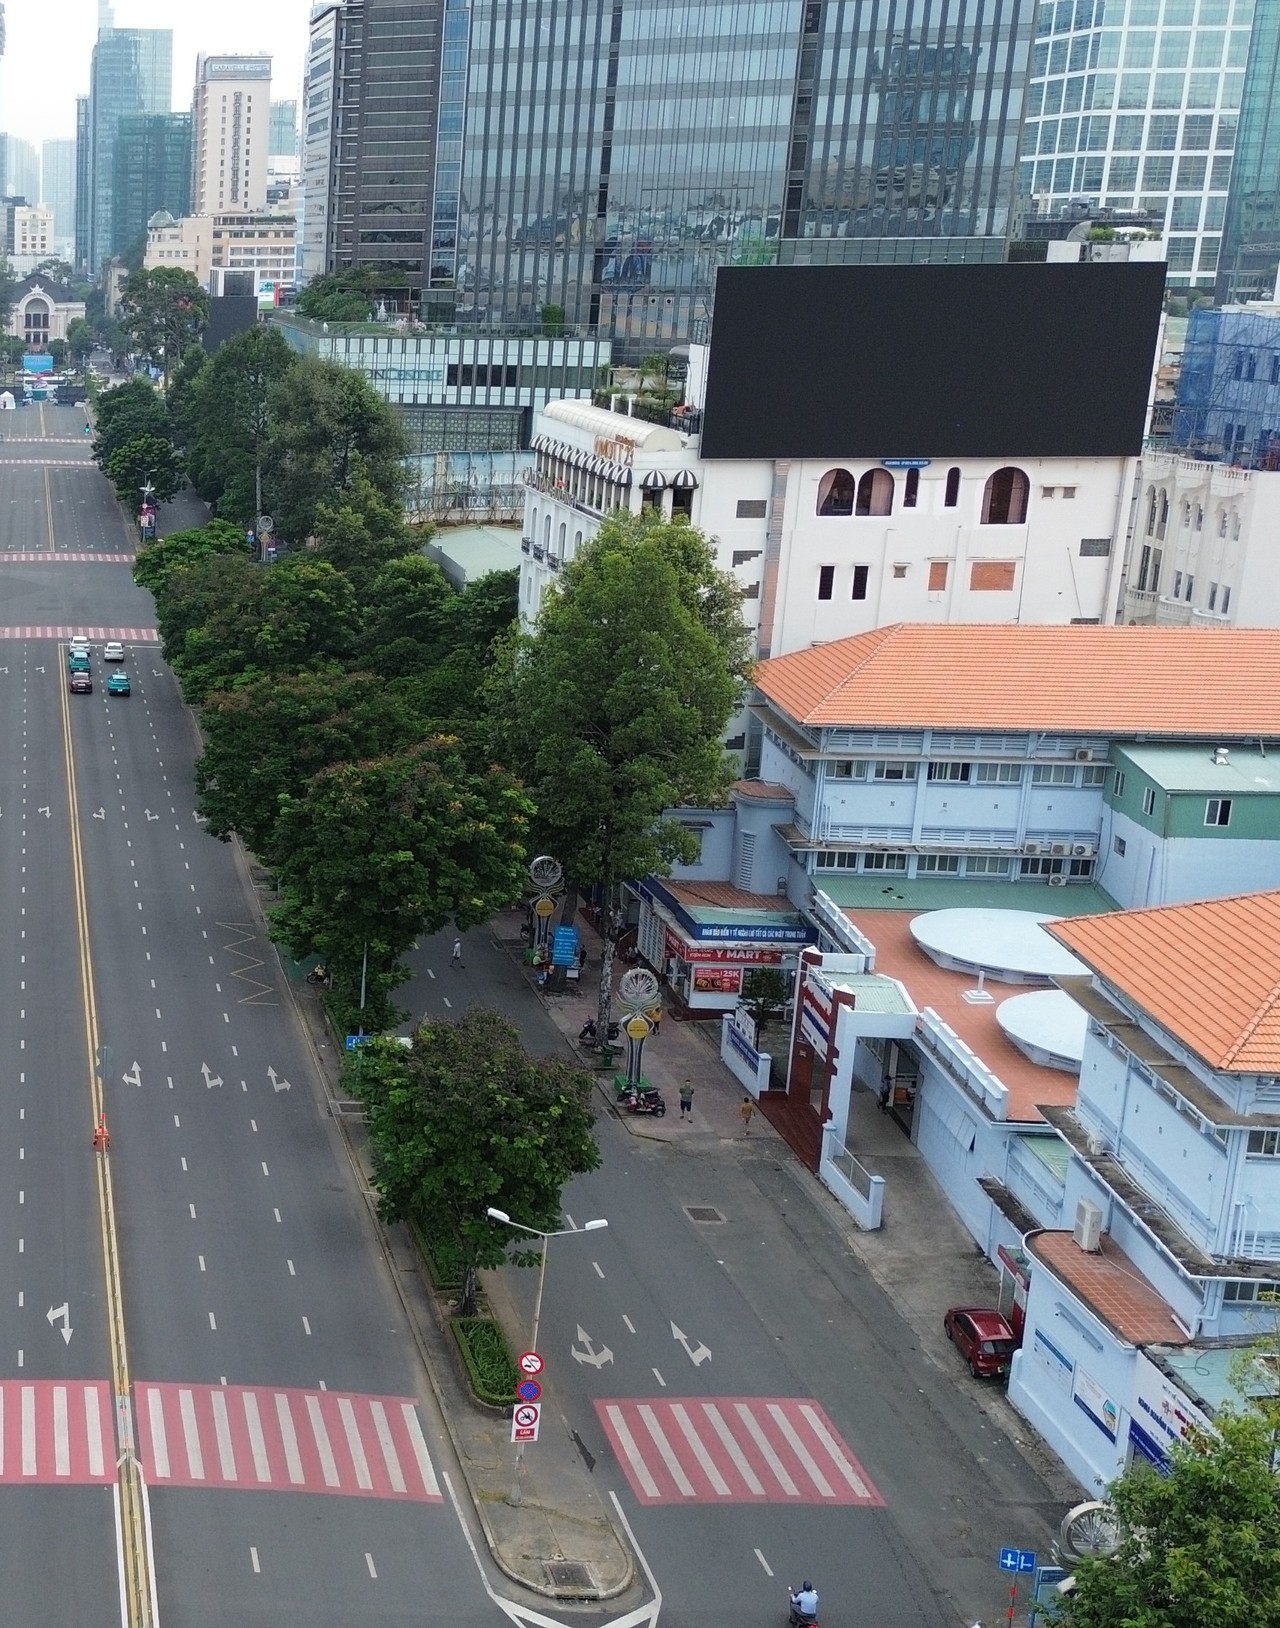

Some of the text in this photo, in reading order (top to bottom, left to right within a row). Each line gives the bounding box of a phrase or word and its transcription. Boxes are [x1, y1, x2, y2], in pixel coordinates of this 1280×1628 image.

[715, 950, 725, 960] Y
[726, 950, 761, 960] MART
[722, 970, 740, 978] 25K
